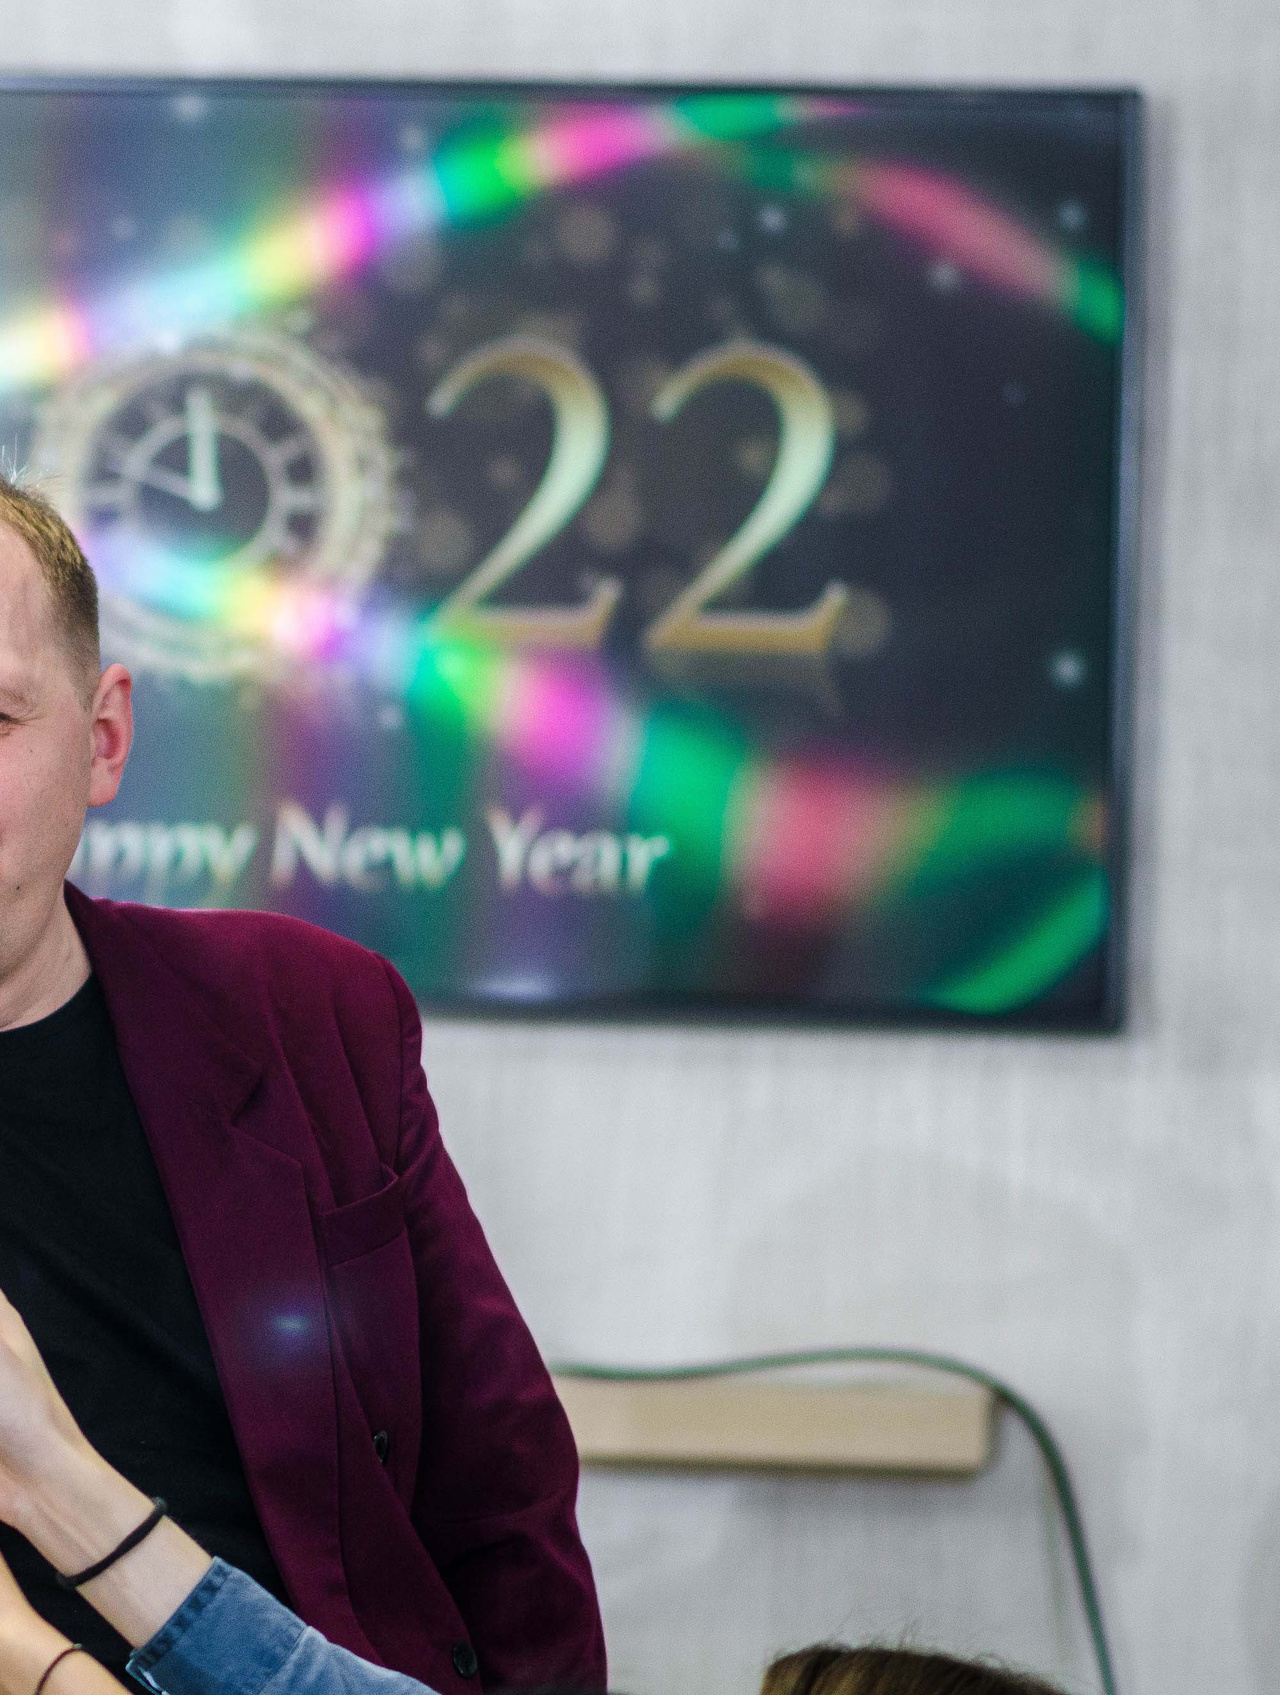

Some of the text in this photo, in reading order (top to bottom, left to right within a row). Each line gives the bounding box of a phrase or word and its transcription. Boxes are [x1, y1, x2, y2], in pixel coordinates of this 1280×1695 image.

[69, 799, 671, 906] ppy New Year
